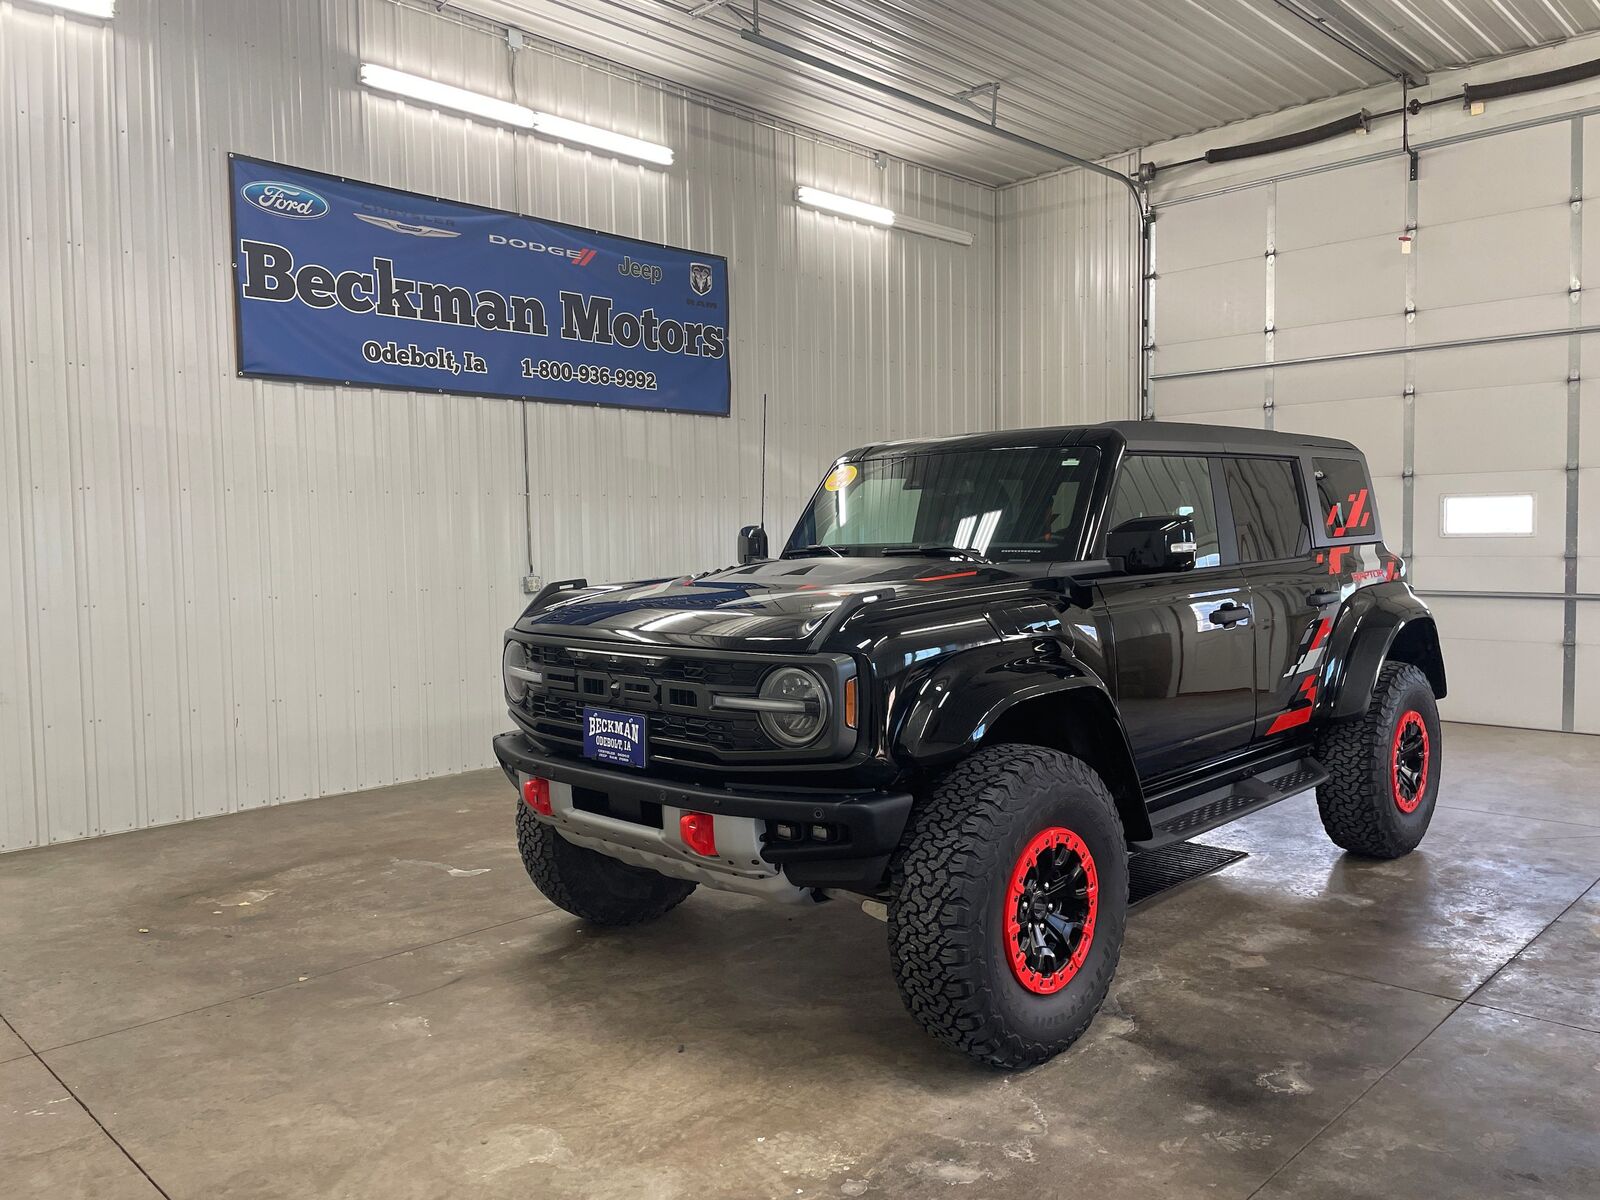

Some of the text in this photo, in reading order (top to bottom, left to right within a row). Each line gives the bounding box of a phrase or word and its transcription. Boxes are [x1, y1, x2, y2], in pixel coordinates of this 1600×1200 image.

[258, 185, 314, 216] Ford
[488, 234, 582, 259] DODGE
[618, 256, 663, 285] Jeep
[240, 238, 725, 359] Beckman Motors
[362, 340, 488, 376] Odebolt, Ia
[520, 357, 658, 391] 1-800-936-9992
[589, 716, 639, 744] BECKMAN
[624, 740, 631, 751] IA
